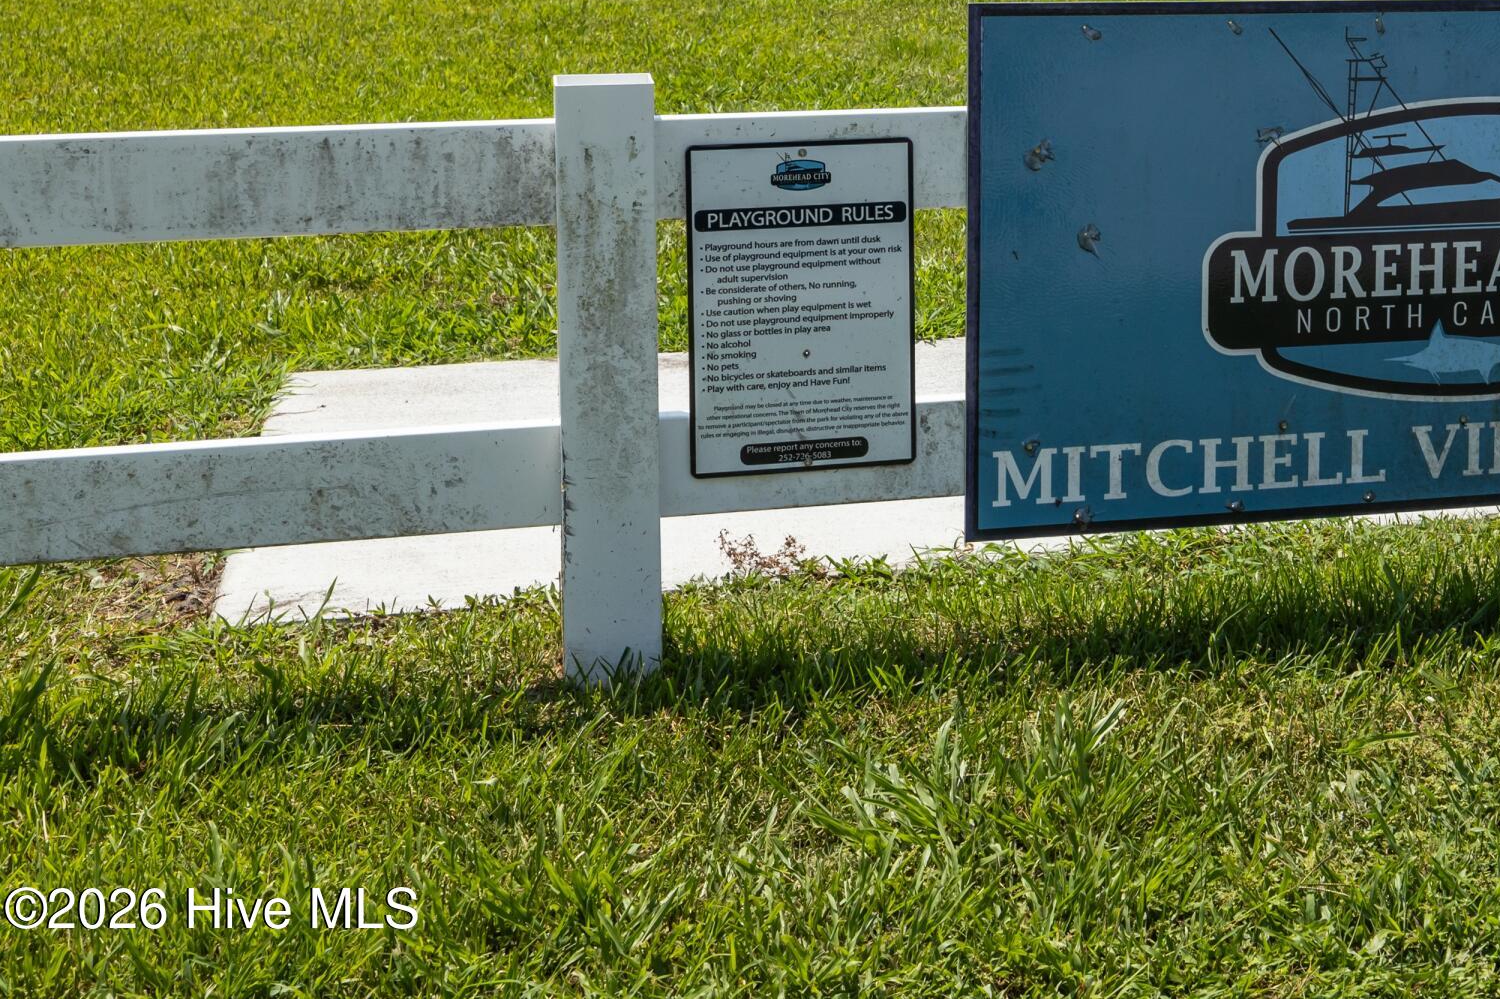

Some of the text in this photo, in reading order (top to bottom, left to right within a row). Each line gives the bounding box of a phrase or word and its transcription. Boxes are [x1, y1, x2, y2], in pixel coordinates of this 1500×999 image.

[771, 171, 830, 181] MOREHEAD CITY
[707, 204, 893, 228] PLAYGROUND RULES
[704, 241, 752, 252] Playground
[754, 240, 778, 248] hours
[794, 238, 814, 246] from
[815, 237, 839, 245] dawn
[840, 236, 859, 244] until
[860, 235, 881, 243] dusk
[704, 254, 720, 262] Use
[722, 253, 732, 261] of
[732, 250, 780, 262] playground
[782, 248, 828, 259] equipment
[829, 248, 836, 256] is
[847, 248, 867, 256] your
[887, 244, 902, 252] risk
[705, 265, 718, 273] Do
[719, 264, 734, 272] not
[752, 260, 800, 272] playground
[801, 258, 847, 269] equipment
[848, 256, 880, 265] without
[716, 272, 788, 283] adult supervision
[705, 287, 716, 295] Be
[717, 284, 767, 294] considerate
[767, 283, 777, 291] of
[808, 281, 820, 289] No
[705, 308, 721, 317] Use
[722, 307, 754, 316] caution
[756, 305, 780, 314] when
[781, 304, 799, 314] play
[800, 302, 846, 313] equipment
[855, 300, 871, 308] wet
[717, 295, 751, 307] pushing
[763, 293, 797, 304] shoving
[705, 319, 719, 328] Do
[720, 319, 735, 327] not
[752, 314, 800, 326] playground
[802, 312, 848, 323] equipment
[849, 309, 894, 321] improperly
[1298, 303, 1423, 333] NORTH
[706, 330, 719, 338] No
[720, 329, 741, 339] glass
[753, 326, 782, 336] bottles
[784, 326, 792, 334] in
[794, 325, 811, 335] play
[706, 339, 751, 349] No alcohol
[706, 349, 756, 361] No smoking
[706, 362, 739, 371] No pets
[706, 374, 719, 382] No
[720, 371, 754, 382] bicycles
[766, 367, 816, 378] skateboards
[817, 366, 834, 375] and
[835, 364, 863, 374] similar
[863, 363, 886, 372] items
[707, 376, 850, 394] Play with care, enjoy and Have Fun!
[746, 444, 771, 454] Please
[773, 443, 797, 453] report
[799, 443, 813, 451] any
[814, 440, 850, 449] concerns
[992, 429, 1386, 507] MITCHELL
